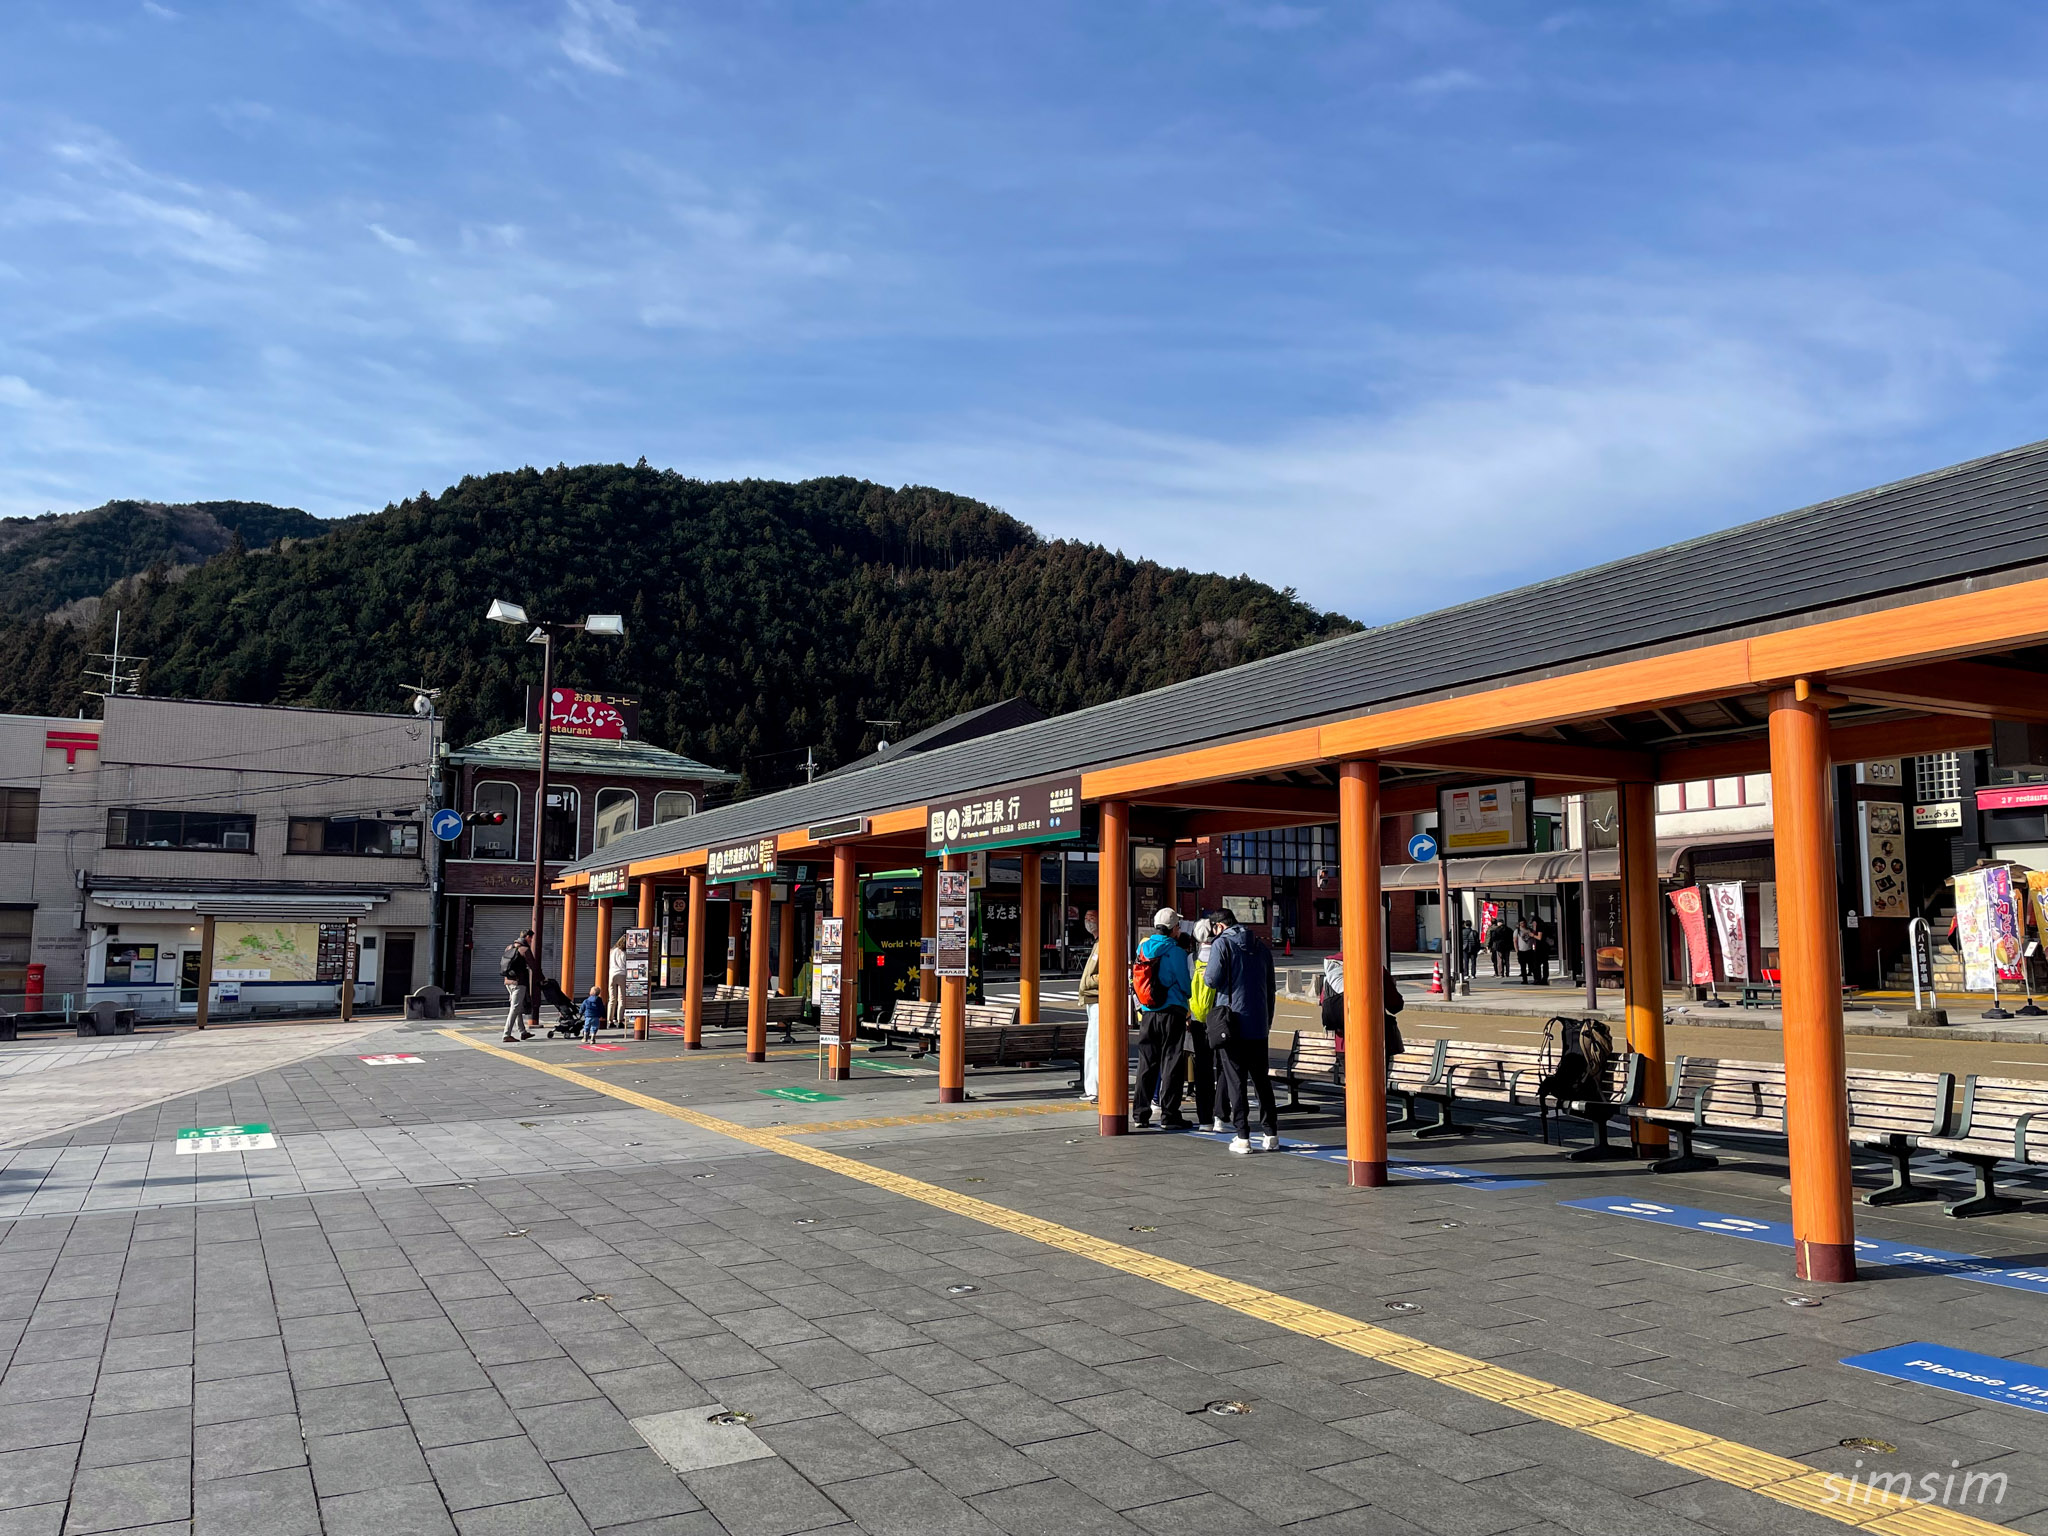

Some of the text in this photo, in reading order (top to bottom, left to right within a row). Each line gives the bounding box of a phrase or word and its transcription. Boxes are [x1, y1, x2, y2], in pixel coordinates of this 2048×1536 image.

[574, 693, 638, 706] お食事 コーヒー
[961, 796, 1021, 828] 湯元温泉 行
[933, 815, 943, 825] BUS
[948, 817, 958, 831] 2A
[1143, 859, 1157, 869] 2A
[1608, 894, 1616, 945] チーズケーキ
[881, 940, 904, 949] World
[1892, 1251, 2003, 1274] Please
[1904, 1359, 2006, 1386] Please
